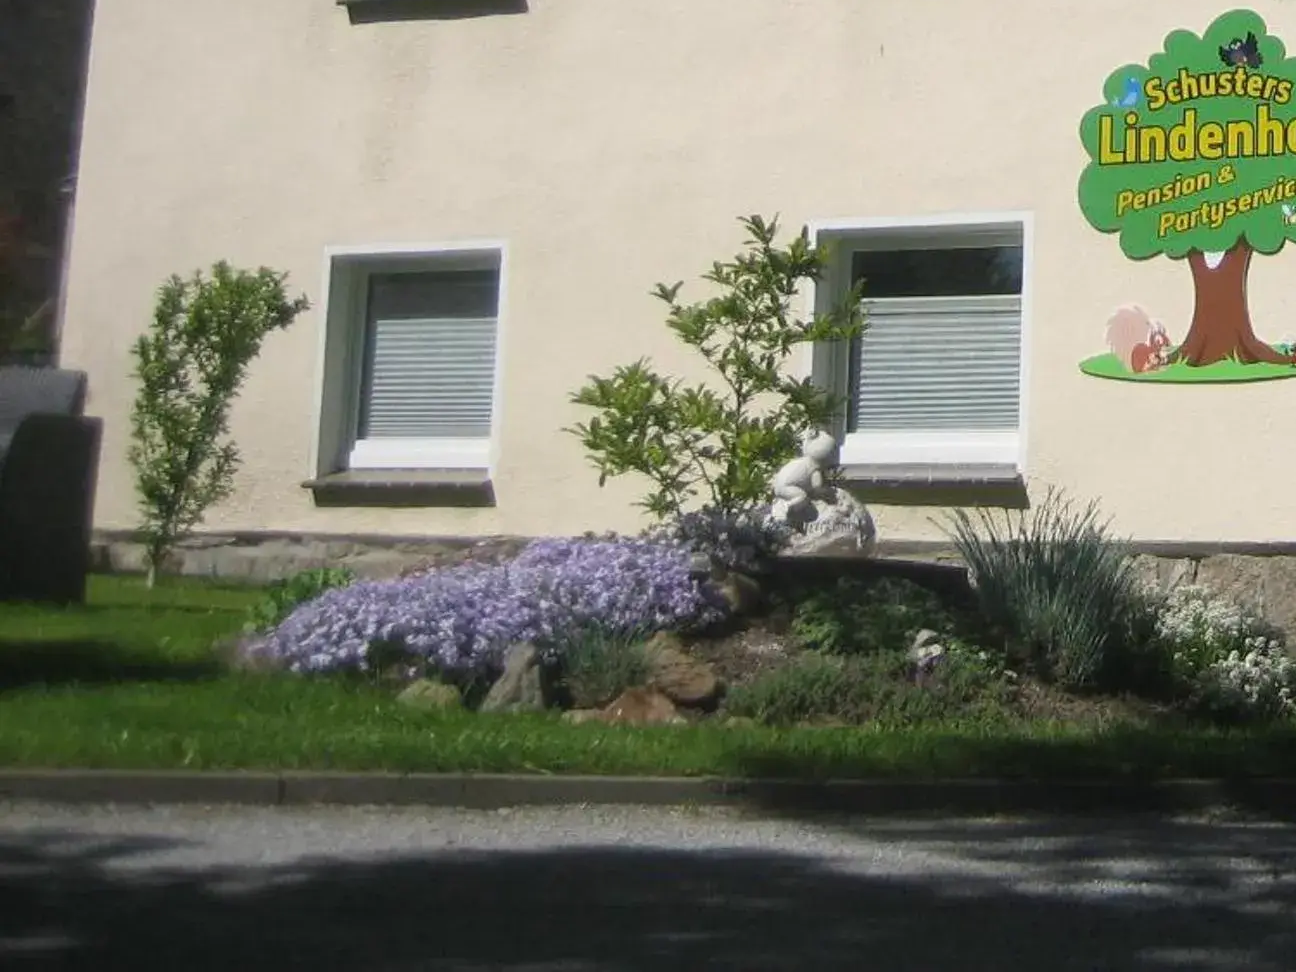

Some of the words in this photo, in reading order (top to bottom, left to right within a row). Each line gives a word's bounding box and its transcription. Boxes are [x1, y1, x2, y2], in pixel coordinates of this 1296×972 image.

[1145, 67, 1293, 111] Schusters
[1116, 171, 1211, 216] Pension
[1217, 163, 1236, 184] &
